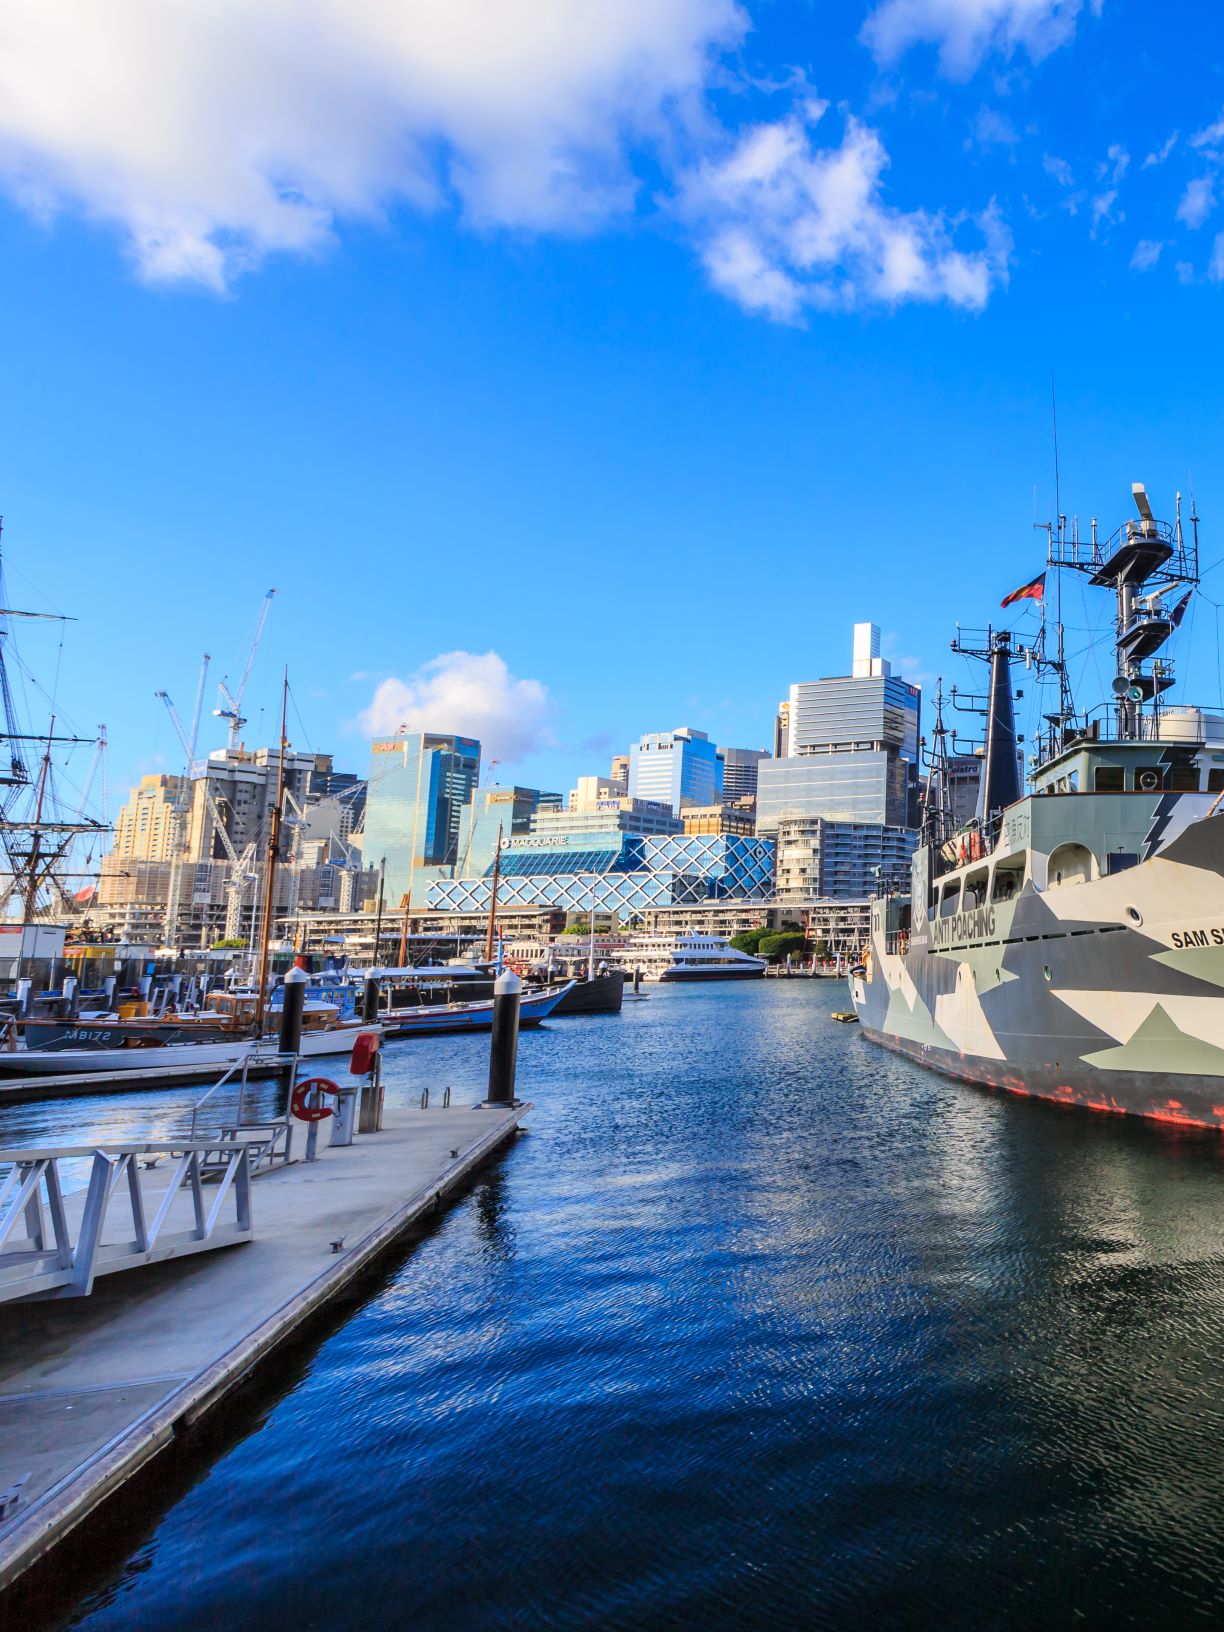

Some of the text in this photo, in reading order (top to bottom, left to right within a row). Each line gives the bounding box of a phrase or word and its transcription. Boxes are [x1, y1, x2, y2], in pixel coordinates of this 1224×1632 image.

[512, 837, 567, 848] MACQUARIE
[934, 906, 995, 945] ANTI POACHING
[1171, 929, 1209, 948] SAM
[64, 1030, 111, 1040] MB172
